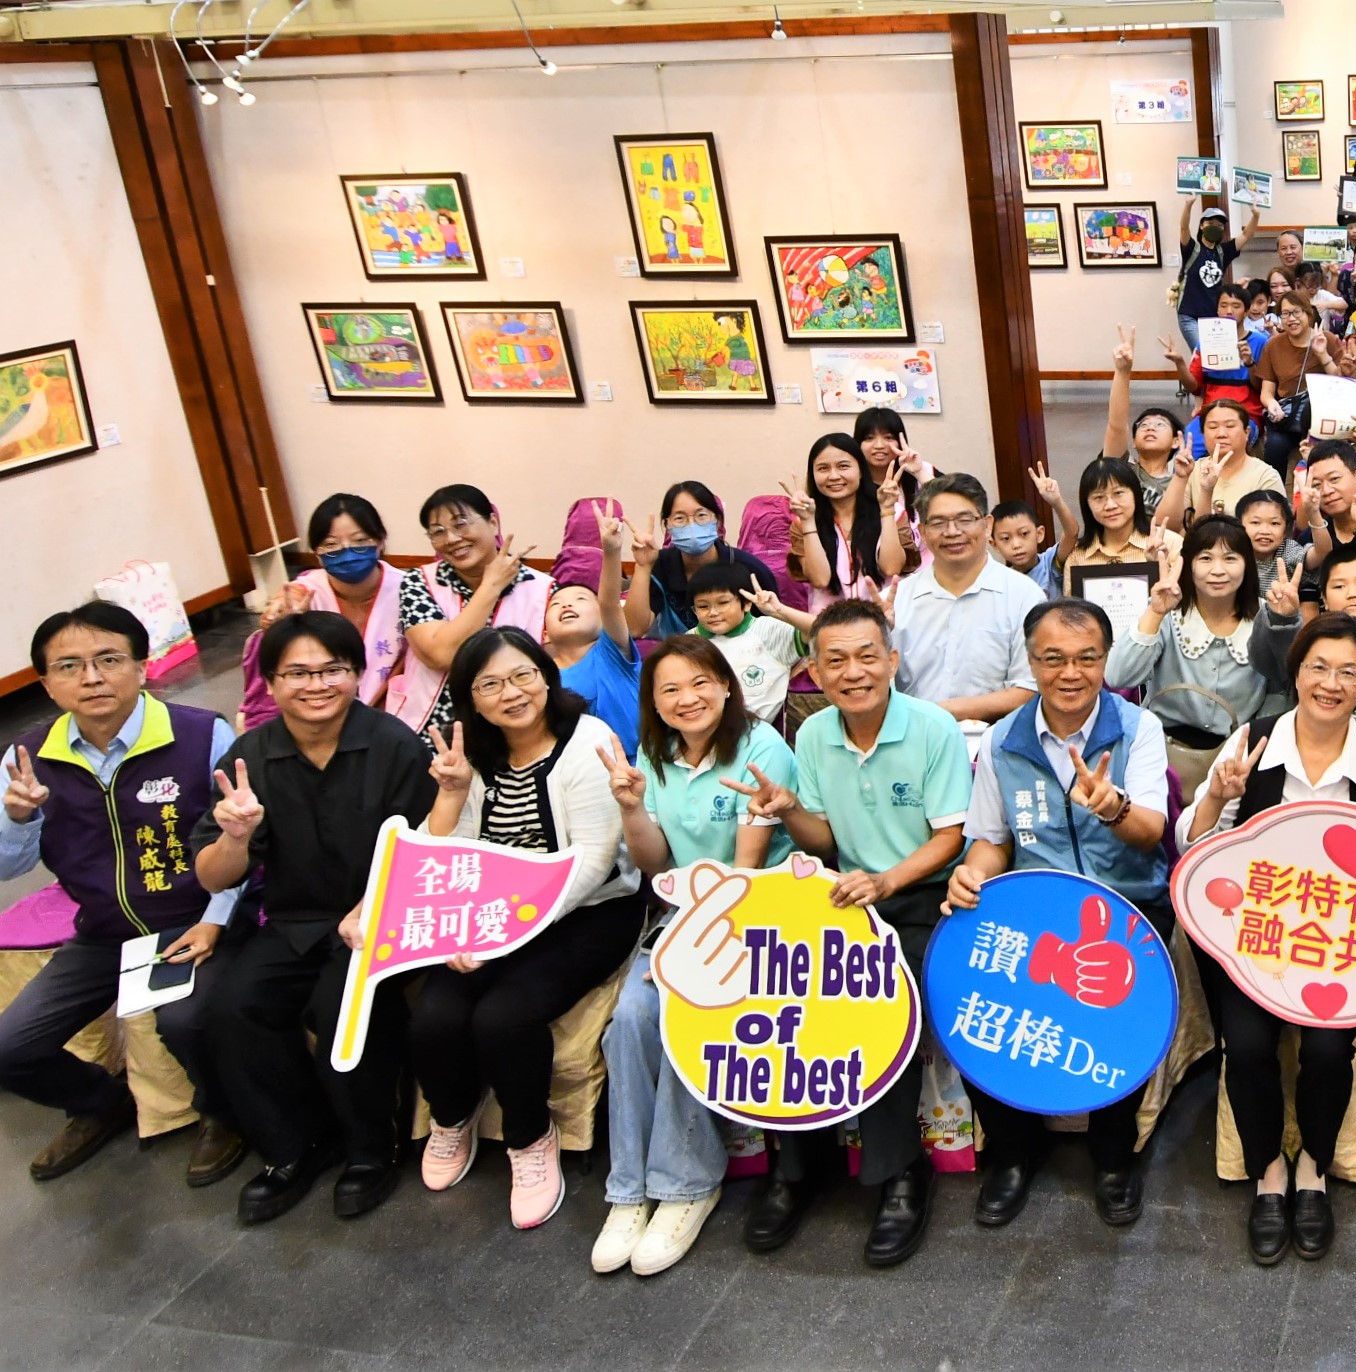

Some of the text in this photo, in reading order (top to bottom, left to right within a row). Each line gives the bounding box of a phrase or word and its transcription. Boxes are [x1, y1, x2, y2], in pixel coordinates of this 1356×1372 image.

[856, 380, 898, 393] 第6組
[413, 852, 482, 896] 全場
[400, 897, 511, 951] 最可愛
[745, 928, 896, 999] The Best
[968, 920, 1030, 984] 讚
[735, 1005, 802, 1045] of
[703, 1044, 771, 1104] The
[782, 1045, 862, 1106] best
